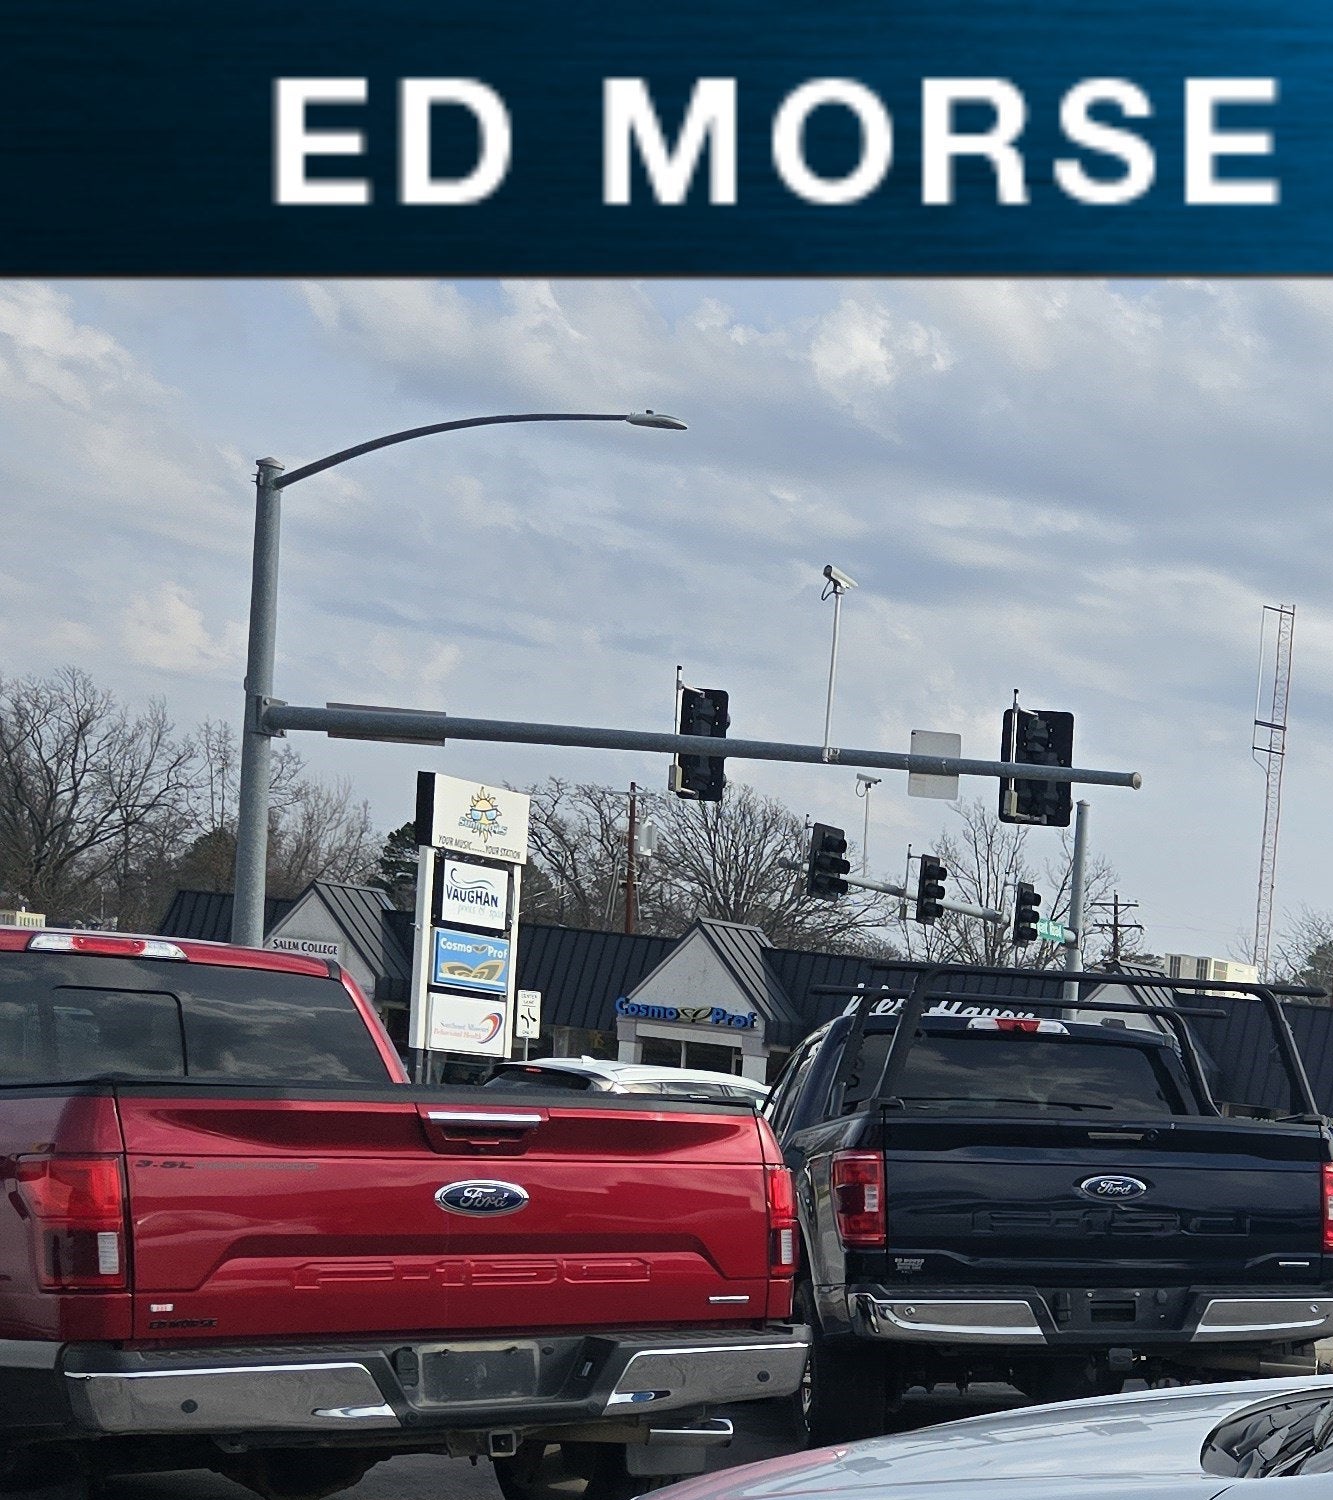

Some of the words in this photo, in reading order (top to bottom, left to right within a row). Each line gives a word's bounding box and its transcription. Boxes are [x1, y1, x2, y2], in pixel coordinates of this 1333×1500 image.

[439, 835, 453, 846] YOUR
[500, 848, 521, 859] STATION
[446, 884, 499, 908] VAUGHAN
[273, 939, 300, 951] SALEM
[301, 941, 338, 955] COLLEGE
[440, 937, 473, 954] Cosmo
[487, 945, 508, 960] Prof
[616, 997, 679, 1022] Cosmo
[711, 1007, 759, 1029] Prof
[459, 1187, 510, 1208] Ford
[1096, 1180, 1132, 1195] Ford
[294, 1257, 652, 1290] F-150
